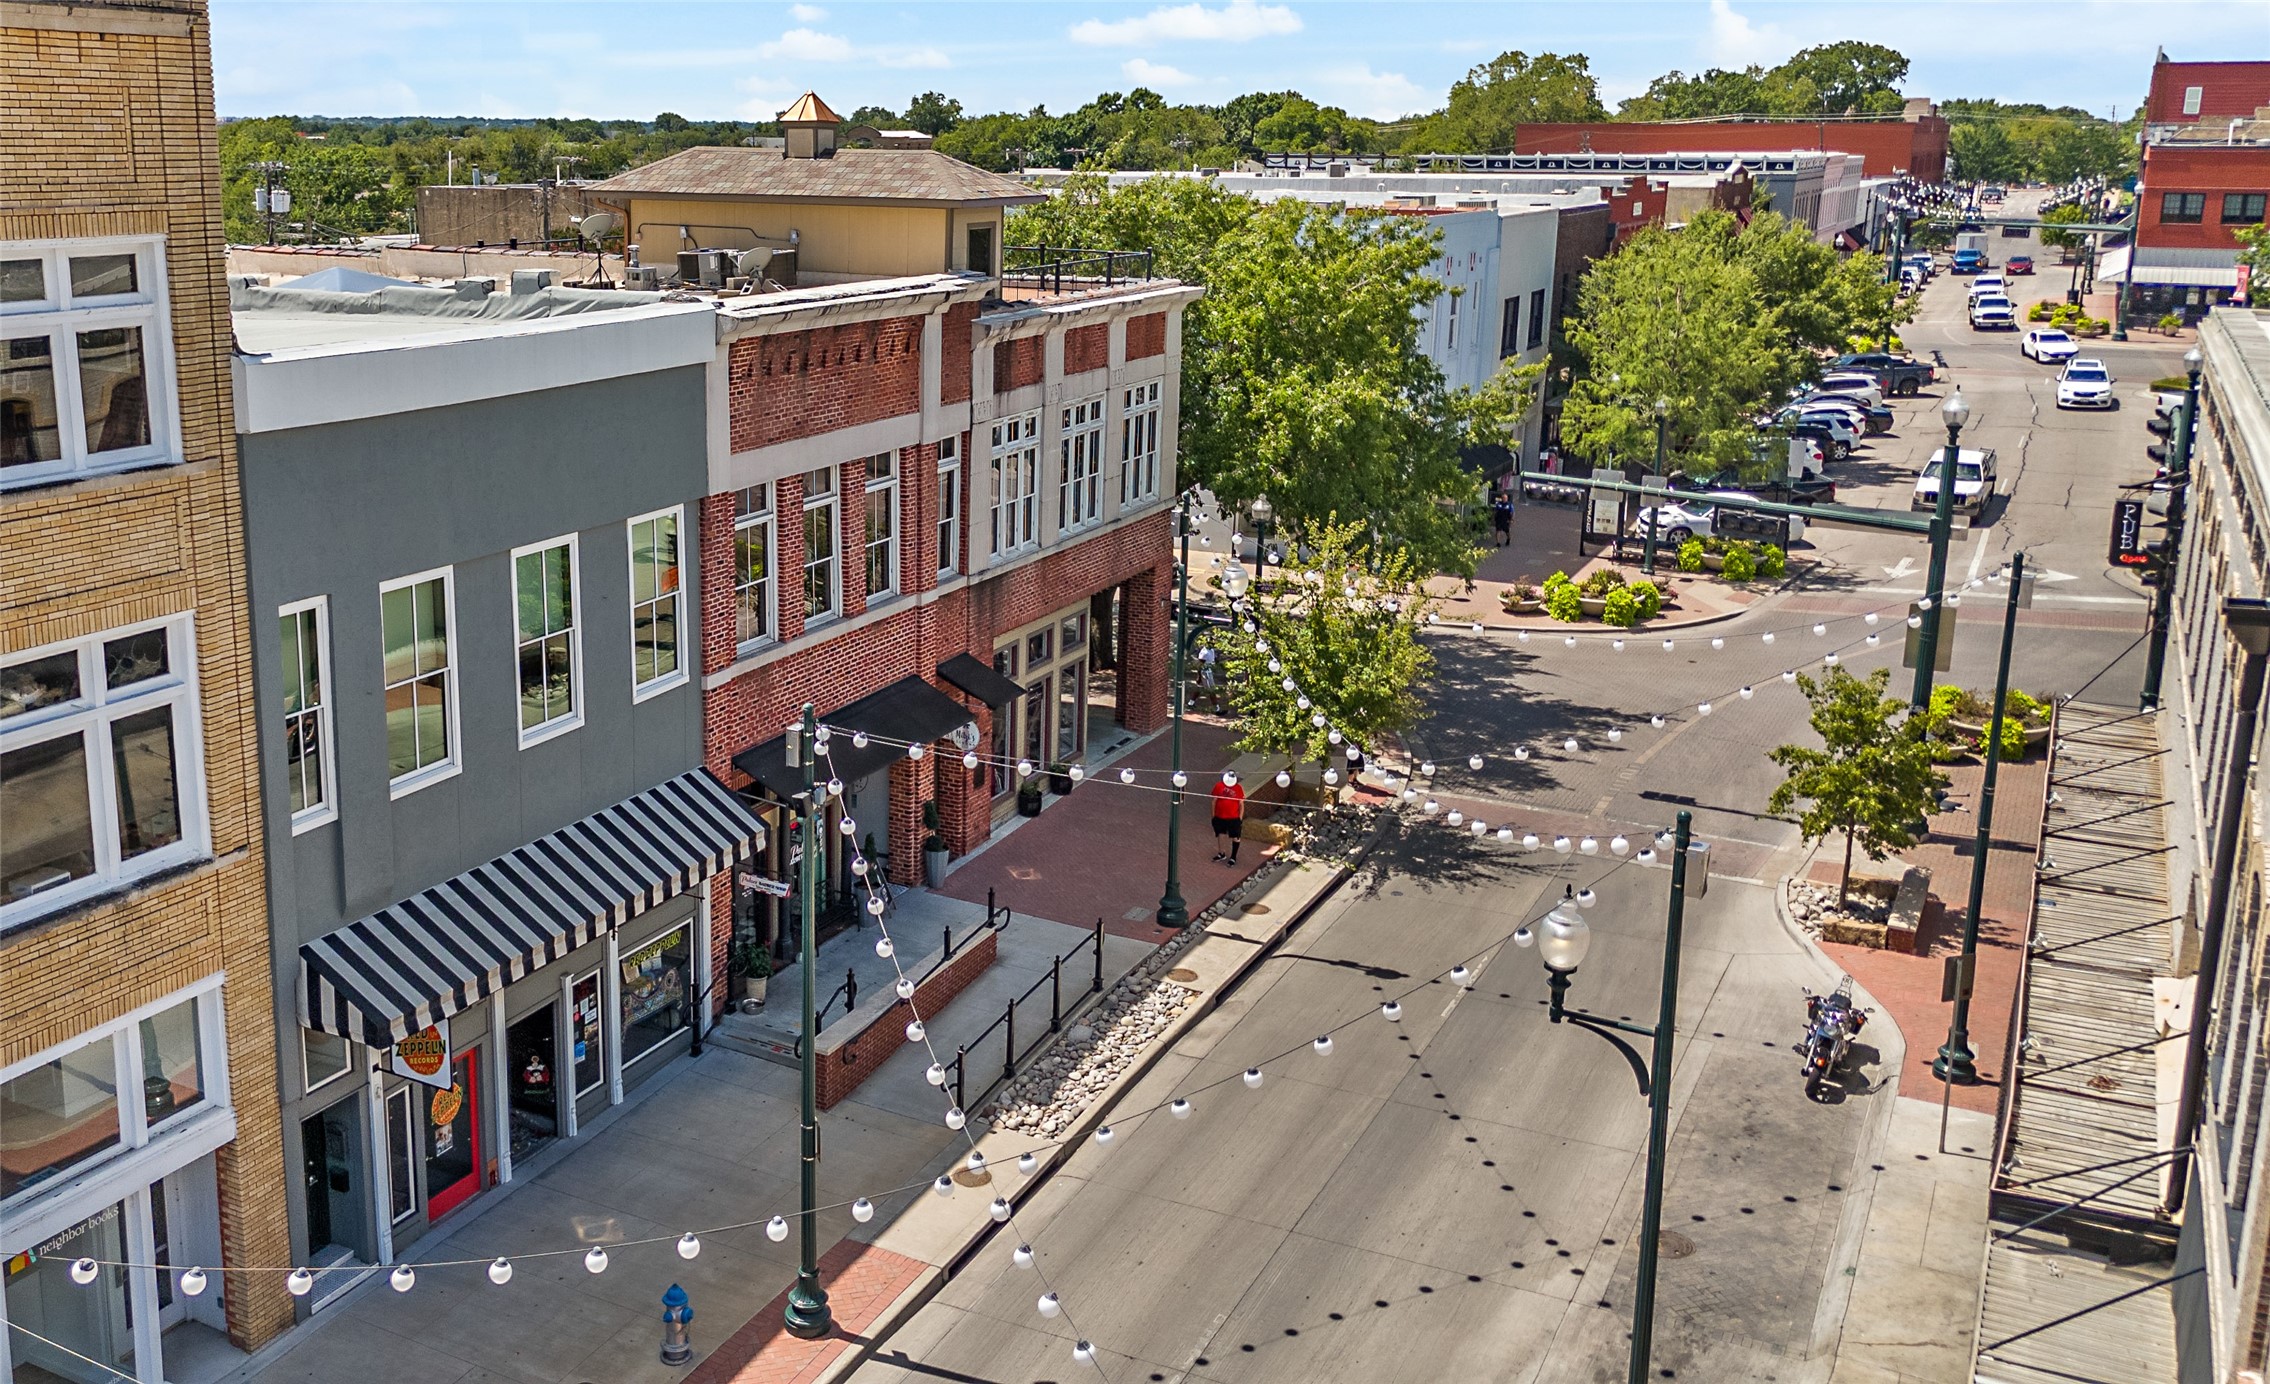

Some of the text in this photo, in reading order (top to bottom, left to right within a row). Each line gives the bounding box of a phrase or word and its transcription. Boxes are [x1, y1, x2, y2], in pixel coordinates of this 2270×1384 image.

[2120, 504, 2136, 549] PUB
[395, 1040, 446, 1057] ZEPPELIN
[39, 1206, 119, 1255] neighbor books
